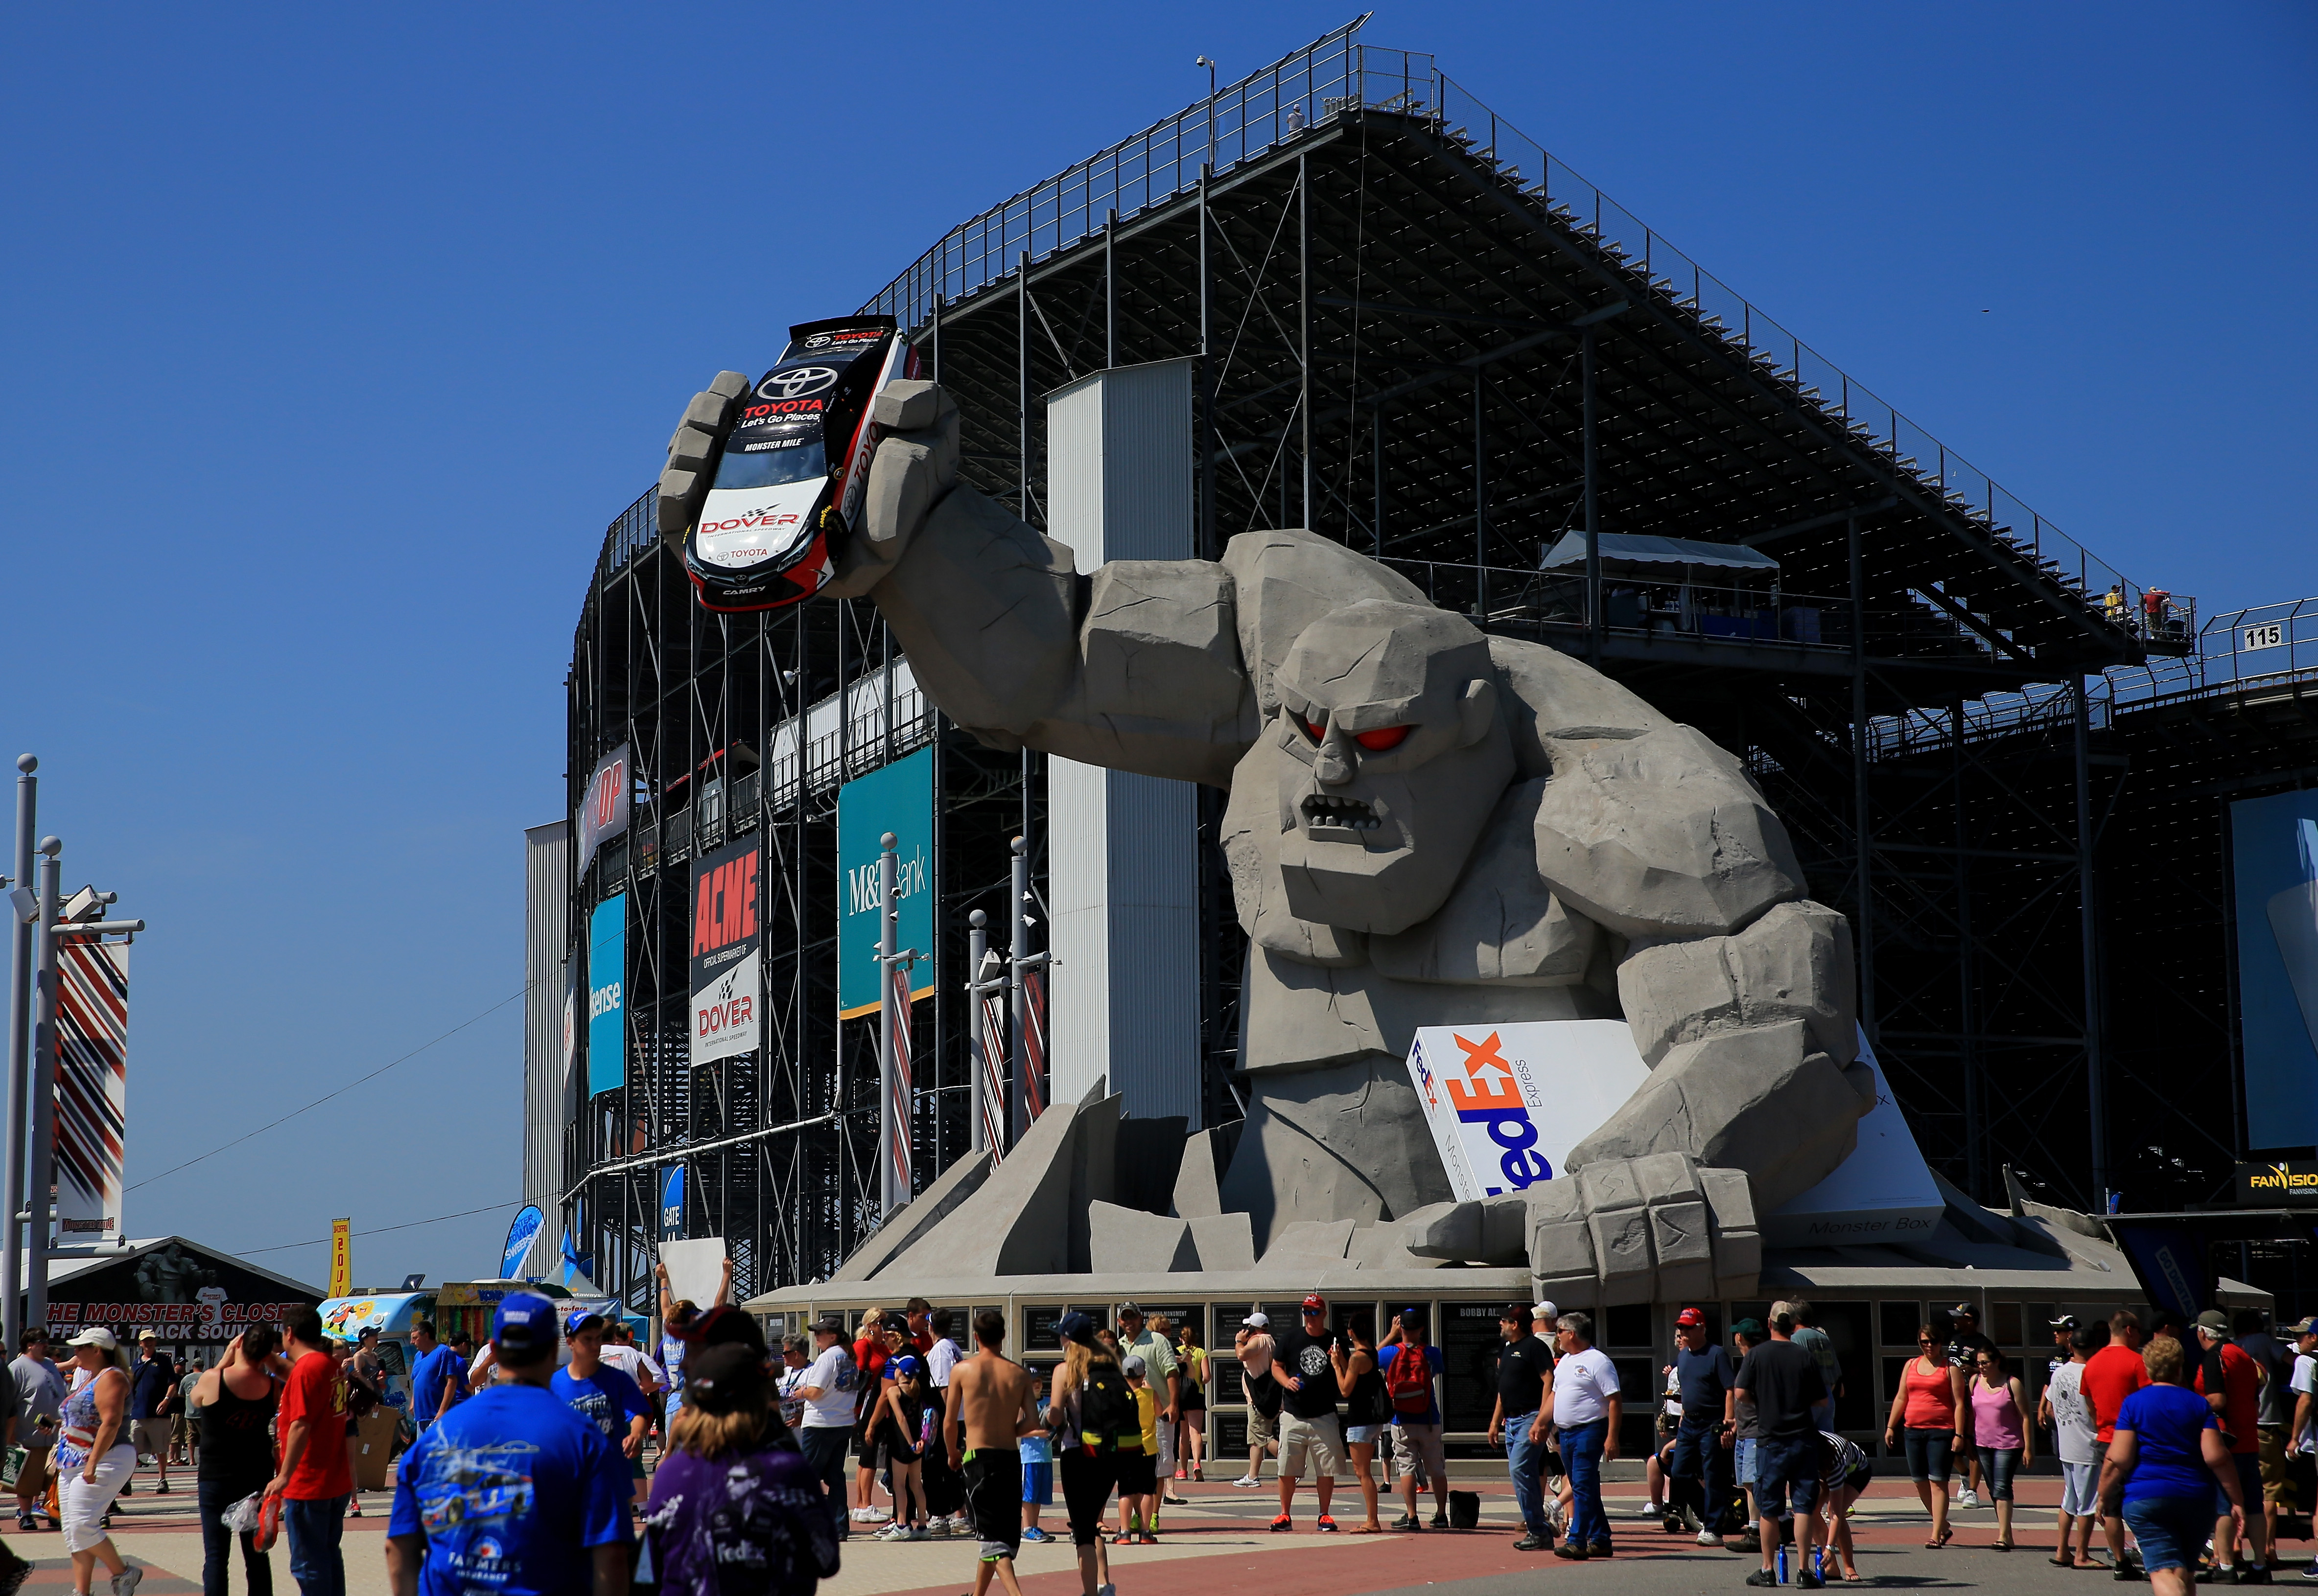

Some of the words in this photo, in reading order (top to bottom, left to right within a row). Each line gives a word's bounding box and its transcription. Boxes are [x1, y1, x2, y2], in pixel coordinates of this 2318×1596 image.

[834, 331, 883, 341] TOYOTA
[744, 399, 822, 419] TOYOTA
[741, 416, 765, 429] Let's
[767, 415, 783, 424] Go
[783, 413, 820, 422] Places
[744, 440, 780, 452] MONSTER
[782, 438, 801, 447] MILE
[854, 412, 879, 484] TOYO
[700, 514, 799, 534] DOVER
[707, 529, 752, 539] INTERNATIONAL
[730, 549, 768, 558] TOYOTA
[723, 586, 766, 595] CAMRY
[2247, 626, 2279, 647] 115
[693, 850, 757, 957] ACME
[703, 955, 718, 969] OFFICIAL
[717, 947, 741, 964] SUPERMARKET
[741, 944, 747, 954] OF
[698, 995, 753, 1039] DOVER
[704, 1036, 728, 1048] INTERNATIONAL
[729, 1031, 747, 1041] SPEEDWAY
[1412, 1038, 1438, 1114] FedEx
[1515, 1059, 1543, 1108] Express
[1445, 1030, 1554, 1198] edEx
[1445, 1134, 1473, 1202] Monste
[63, 1218, 96, 1231] MONSTER
[96, 1217, 115, 1230] MILE
[514, 1214, 534, 1231] ENTER
[664, 1206, 680, 1227] GATE
[1809, 1218, 1891, 1235] Monster
[1895, 1217, 1932, 1230] Box
[509, 1234, 517, 1245] TO
[515, 1220, 539, 1241] WIN
[505, 1233, 534, 1260] SWEEPS
[2159, 1251, 2172, 1269] GO
[85, 1303, 215, 1322] MONSTER'S
[1460, 1307, 1486, 1317] BOBBY
